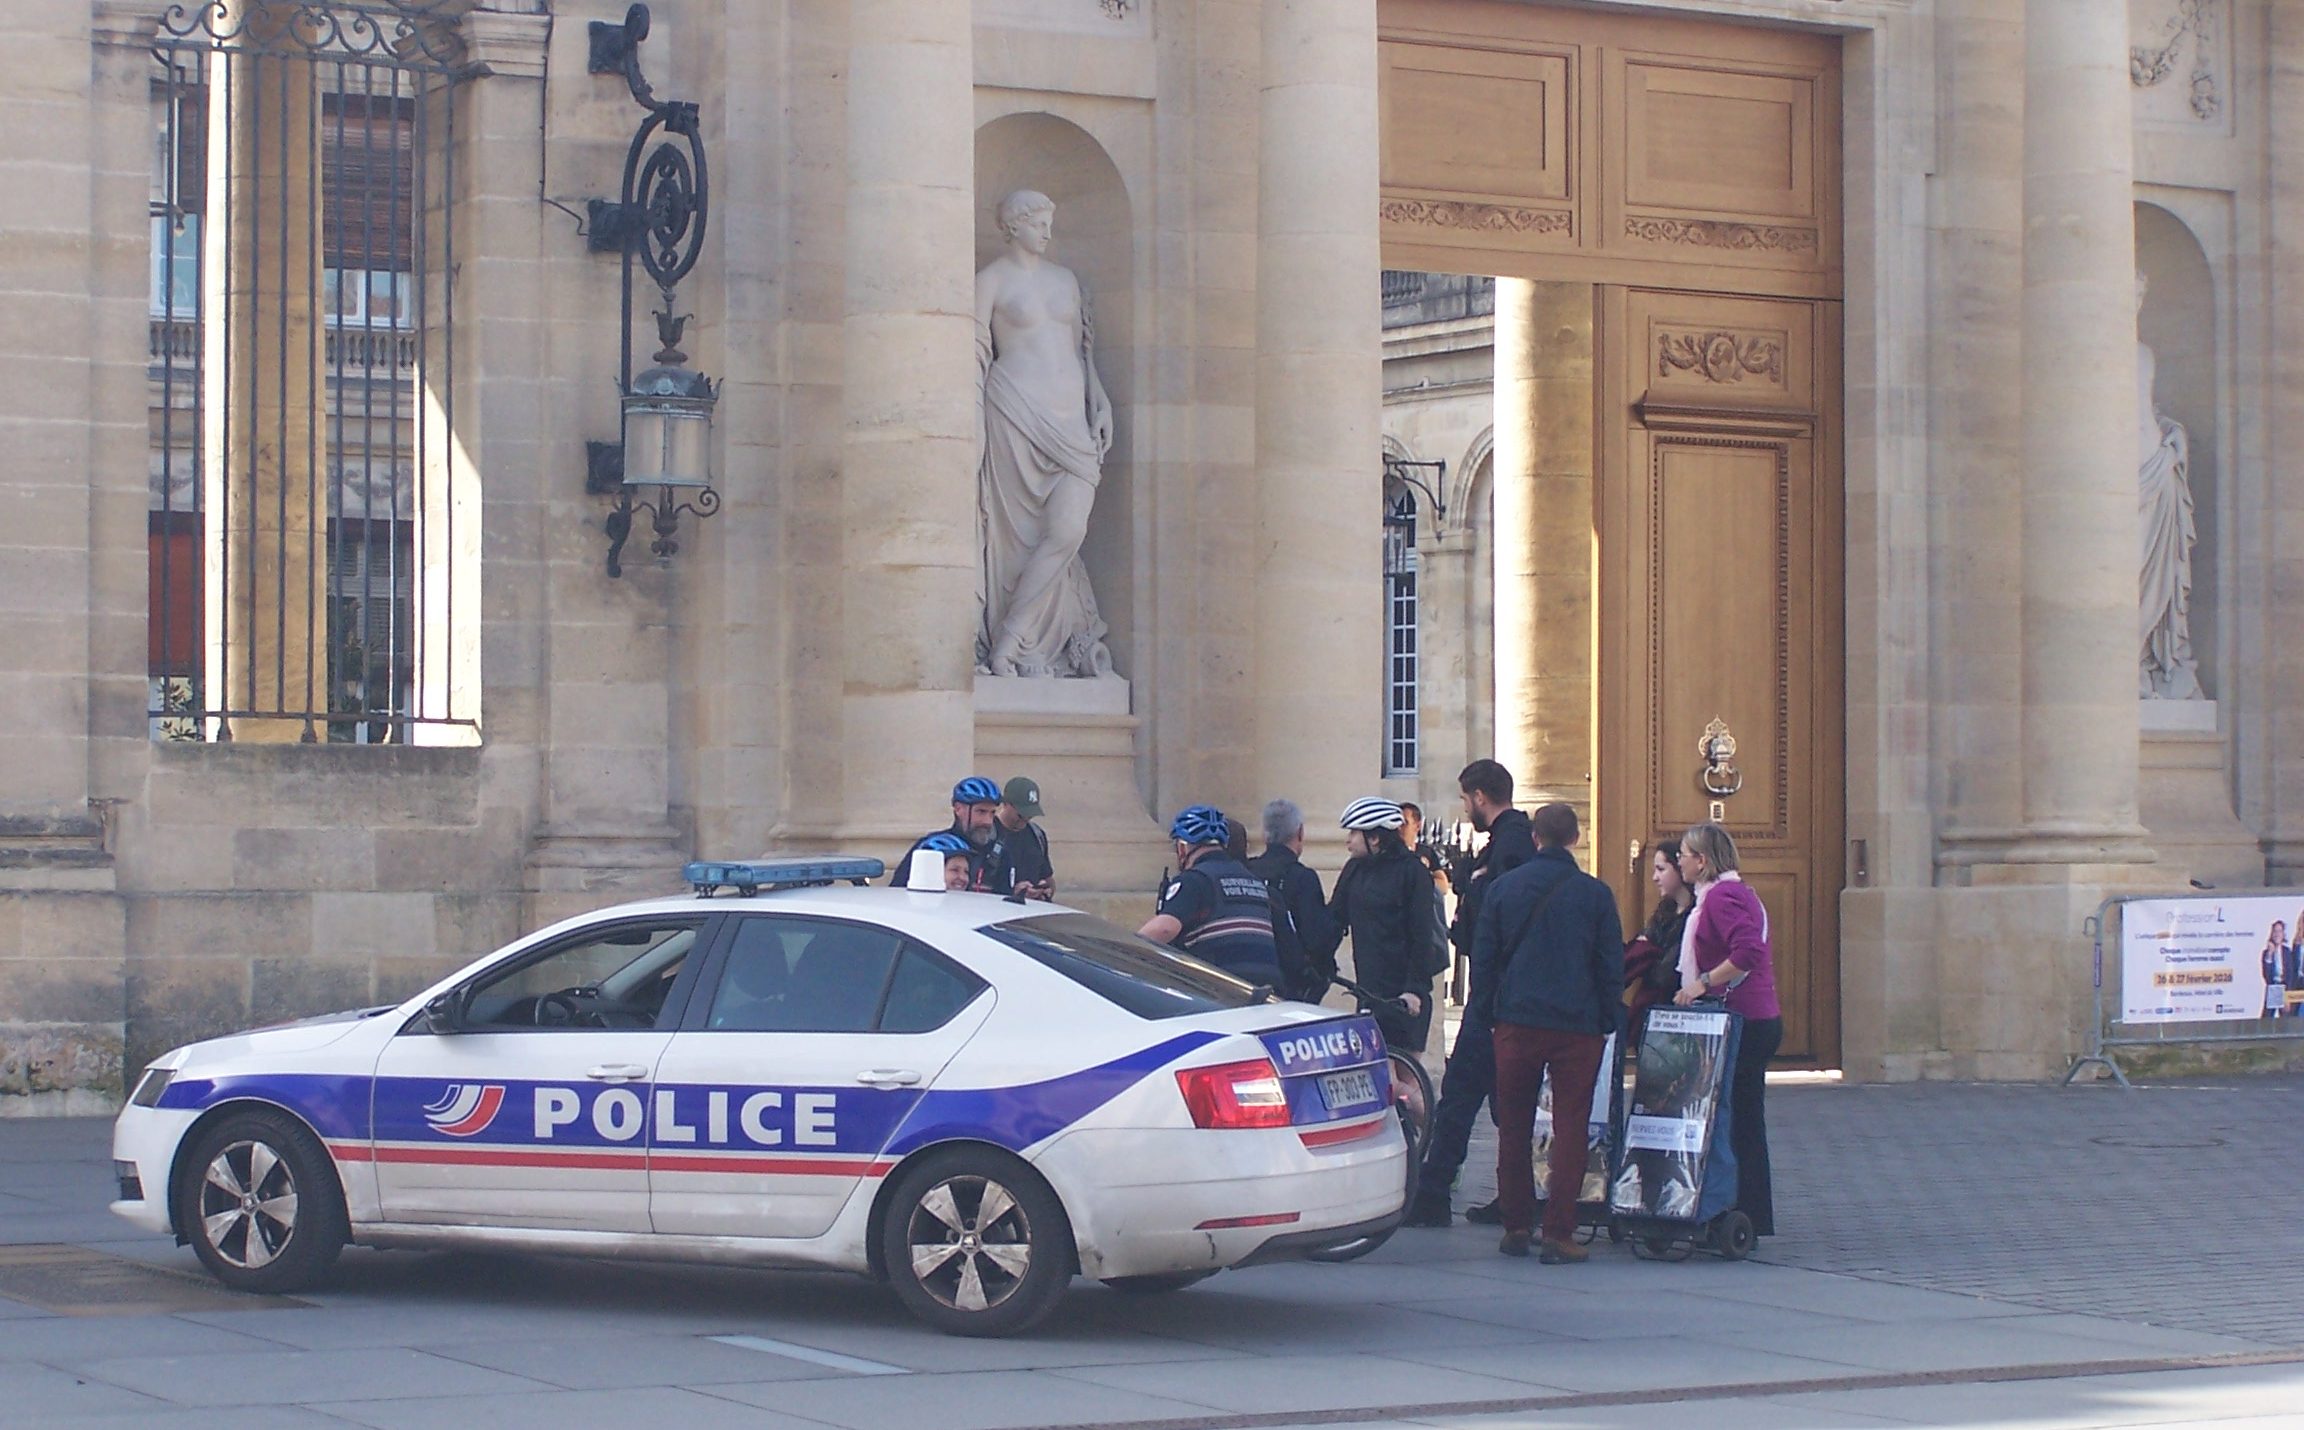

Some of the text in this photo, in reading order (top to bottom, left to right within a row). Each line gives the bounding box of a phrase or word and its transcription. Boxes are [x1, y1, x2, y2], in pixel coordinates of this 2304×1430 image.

[2176, 974, 2186, 983] 27
[1278, 1031, 1349, 1065] POLICE
[533, 1086, 837, 1146] POLICE
